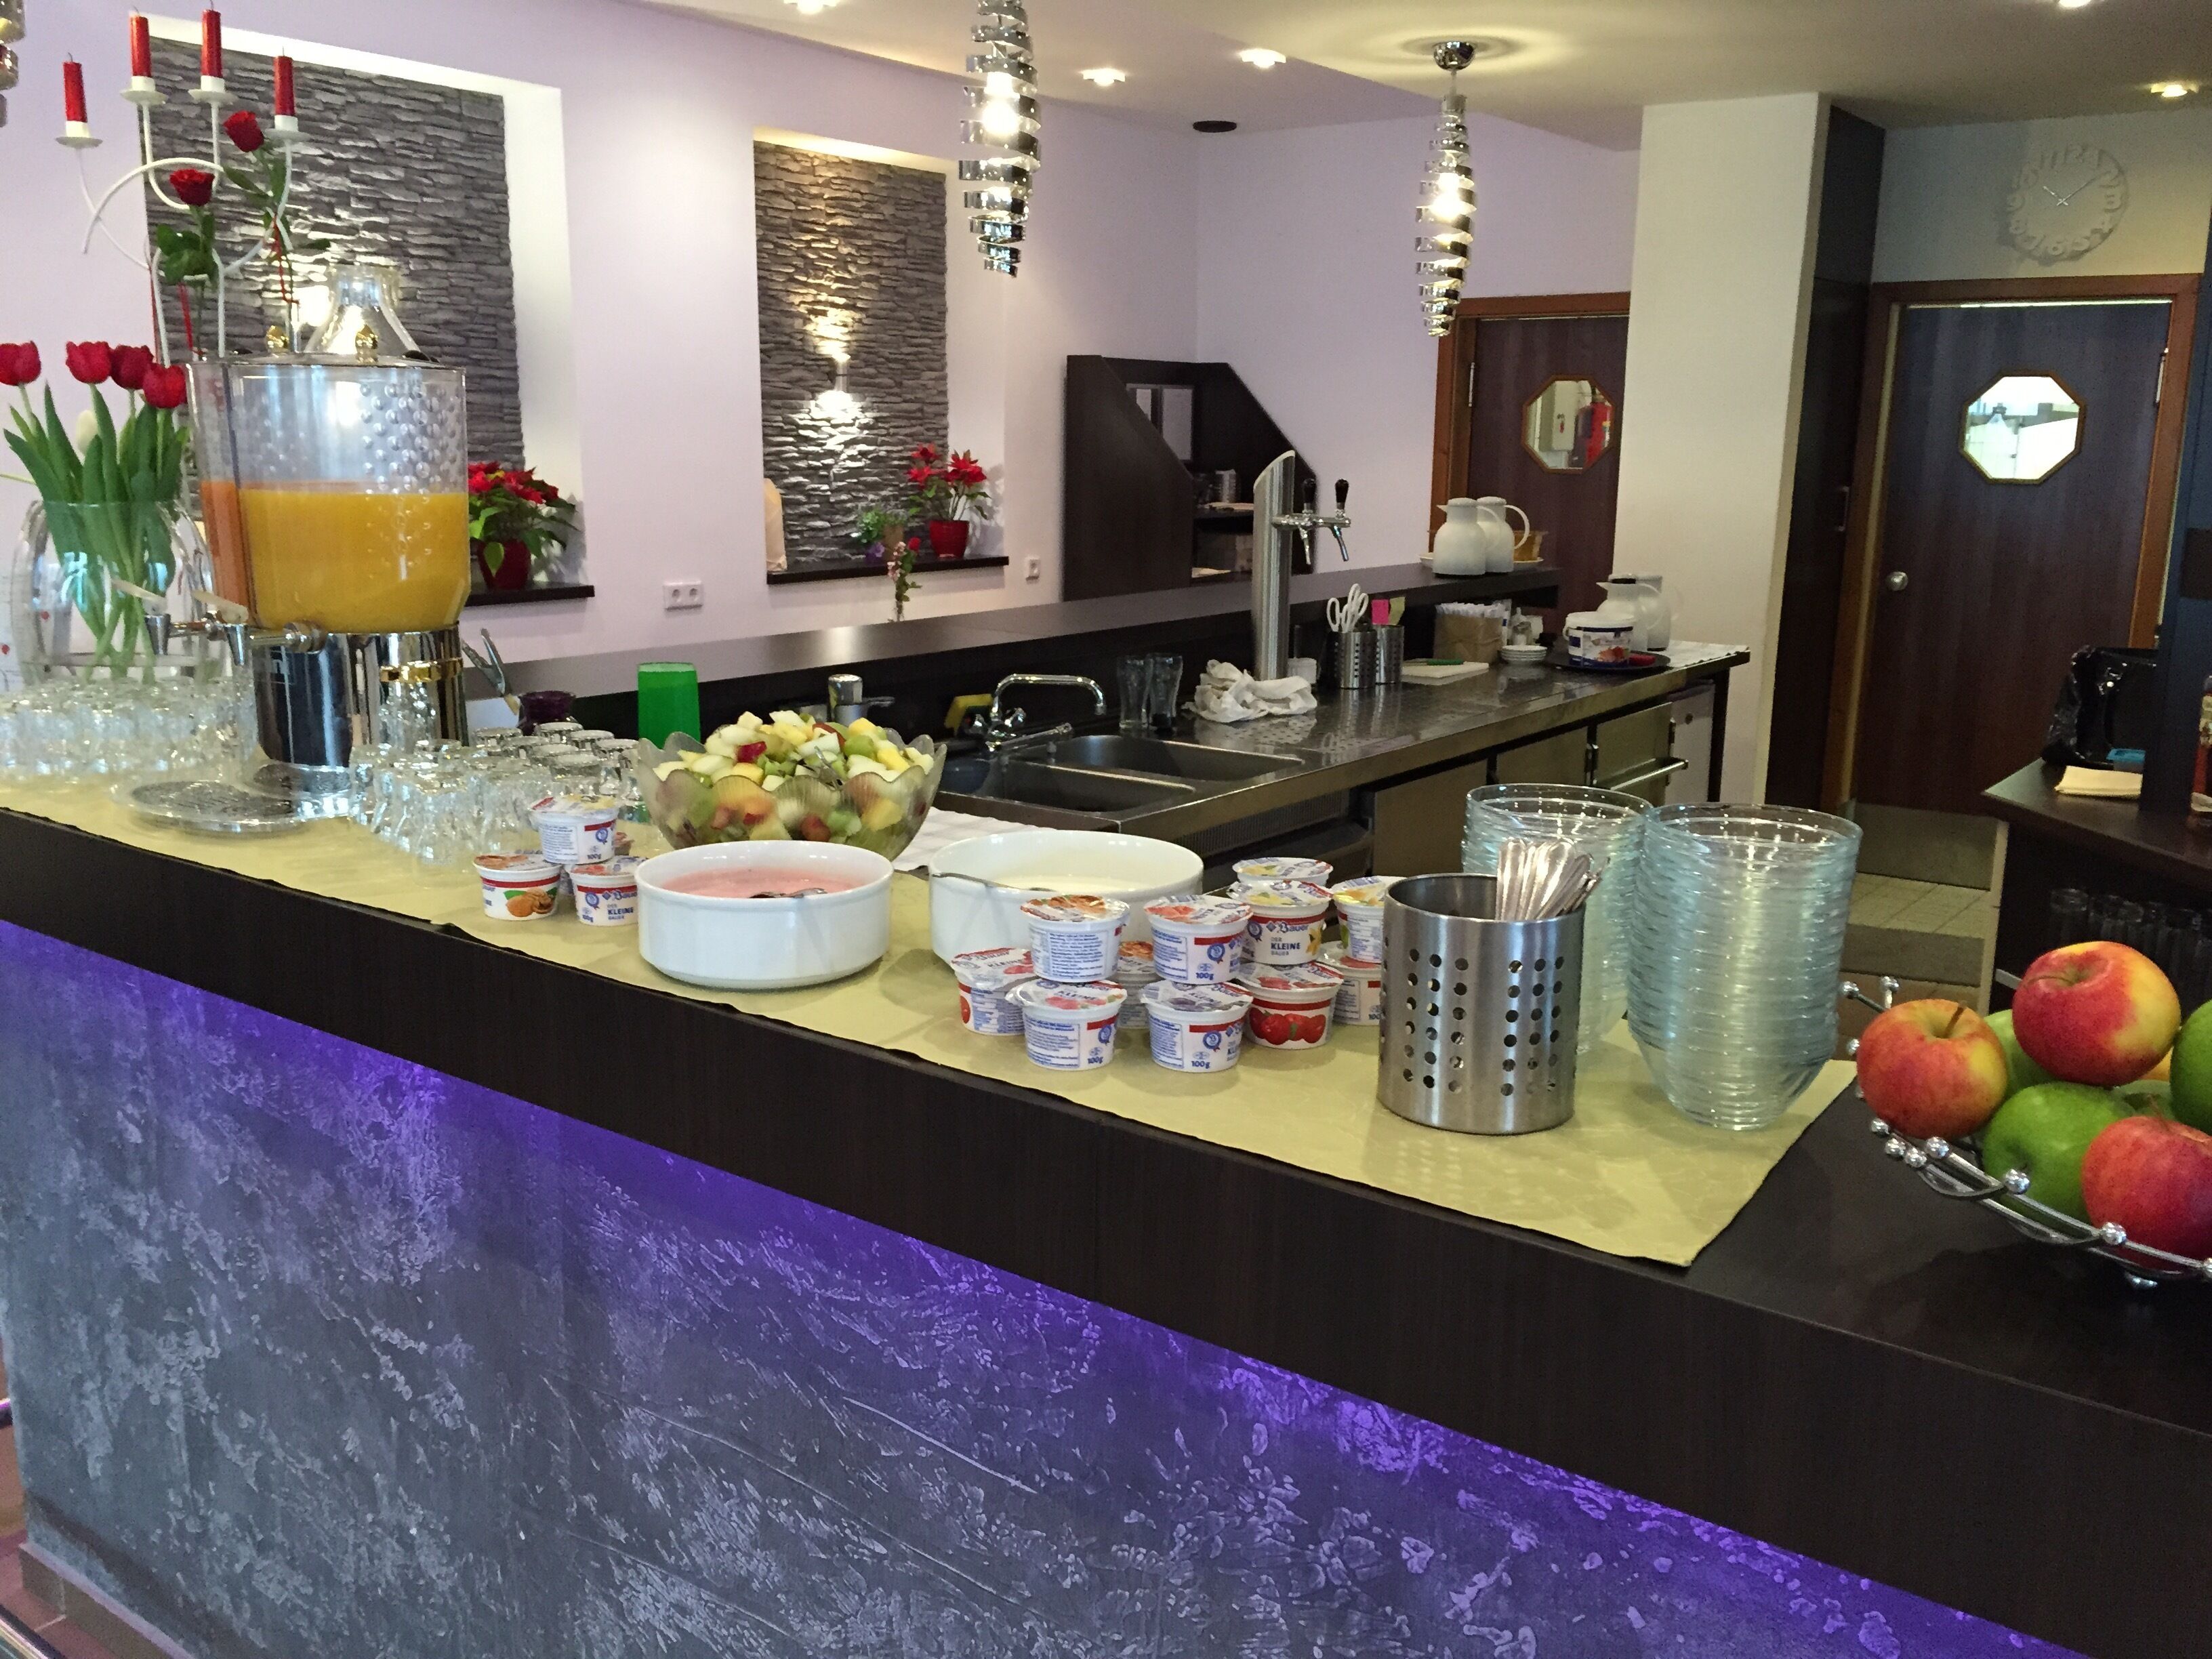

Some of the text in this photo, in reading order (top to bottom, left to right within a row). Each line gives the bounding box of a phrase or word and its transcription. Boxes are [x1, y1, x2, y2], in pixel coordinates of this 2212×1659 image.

[608, 907, 634, 916] KLEINE
[1277, 920, 1309, 934] Bauer
[1271, 942, 1301, 950] KLEINE
[1195, 972, 1214, 981] 100g
[1087, 1057, 1104, 1065] 100g
[1191, 1060, 1210, 1069] 100g
